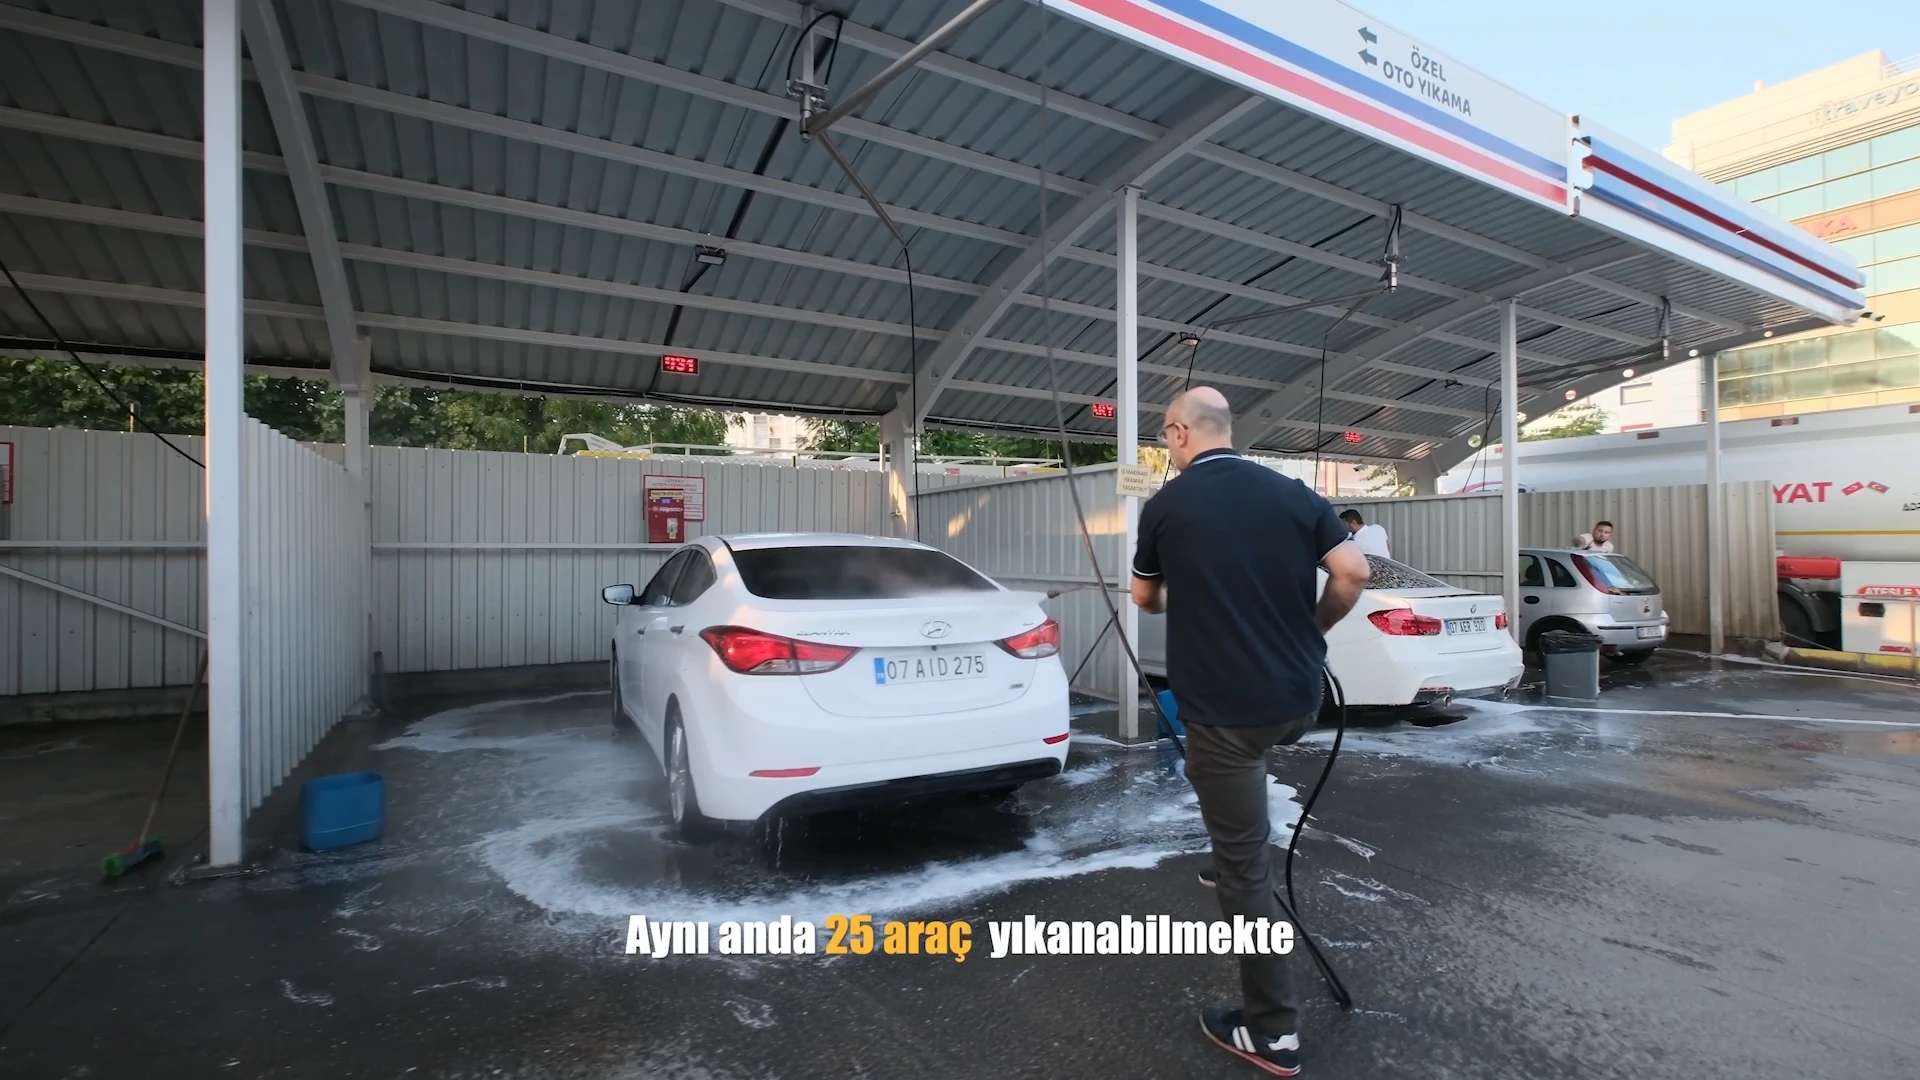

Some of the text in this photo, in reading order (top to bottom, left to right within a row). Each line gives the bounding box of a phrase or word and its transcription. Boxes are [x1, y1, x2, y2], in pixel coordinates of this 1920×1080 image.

[1411, 45, 1446, 82] ÖZEL
[1383, 60, 1472, 117] OTO YIKAMA
[1772, 481, 1833, 504] YAT
[887, 660, 909, 680] 07
[916, 657, 948, 678] AID
[953, 655, 985, 675] 275
